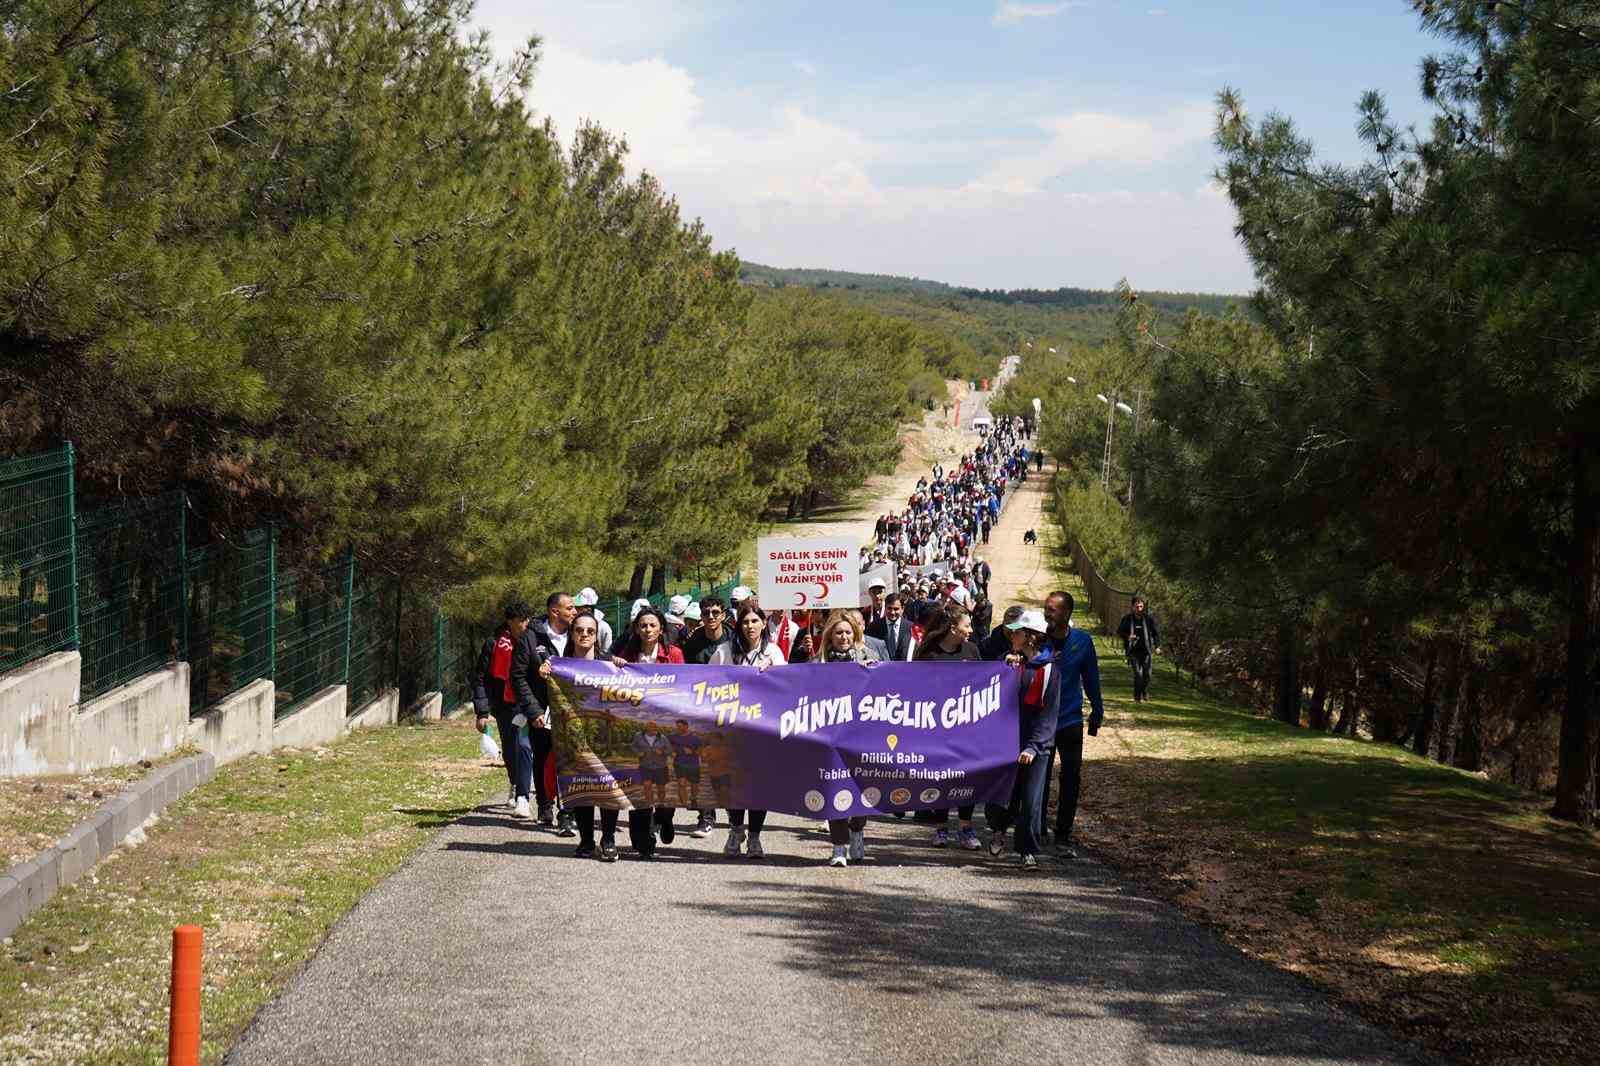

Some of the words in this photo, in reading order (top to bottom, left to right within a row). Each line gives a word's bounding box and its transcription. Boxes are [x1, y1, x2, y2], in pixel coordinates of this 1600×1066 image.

[769, 549, 810, 560] SAĞLIK
[814, 549, 848, 560] SENİN
[780, 563, 796, 572] EN
[799, 561, 838, 572] BÜYÜK
[775, 574, 843, 584] HAZİNENDİR
[574, 673, 676, 688] Koşabiliyorken
[601, 687, 645, 706] KOŞ
[693, 681, 739, 705] 7'DEN
[780, 695, 853, 740] DÜNYA
[857, 693, 936, 730] SAĞLIK
[941, 674, 1001, 729] GÜNÜ
[860, 752, 893, 764] Dülük
[896, 753, 925, 764] Baba
[818, 768, 851, 780] Tabiat
[854, 767, 905, 779] Parkında
[908, 768, 966, 781] Buluşalım
